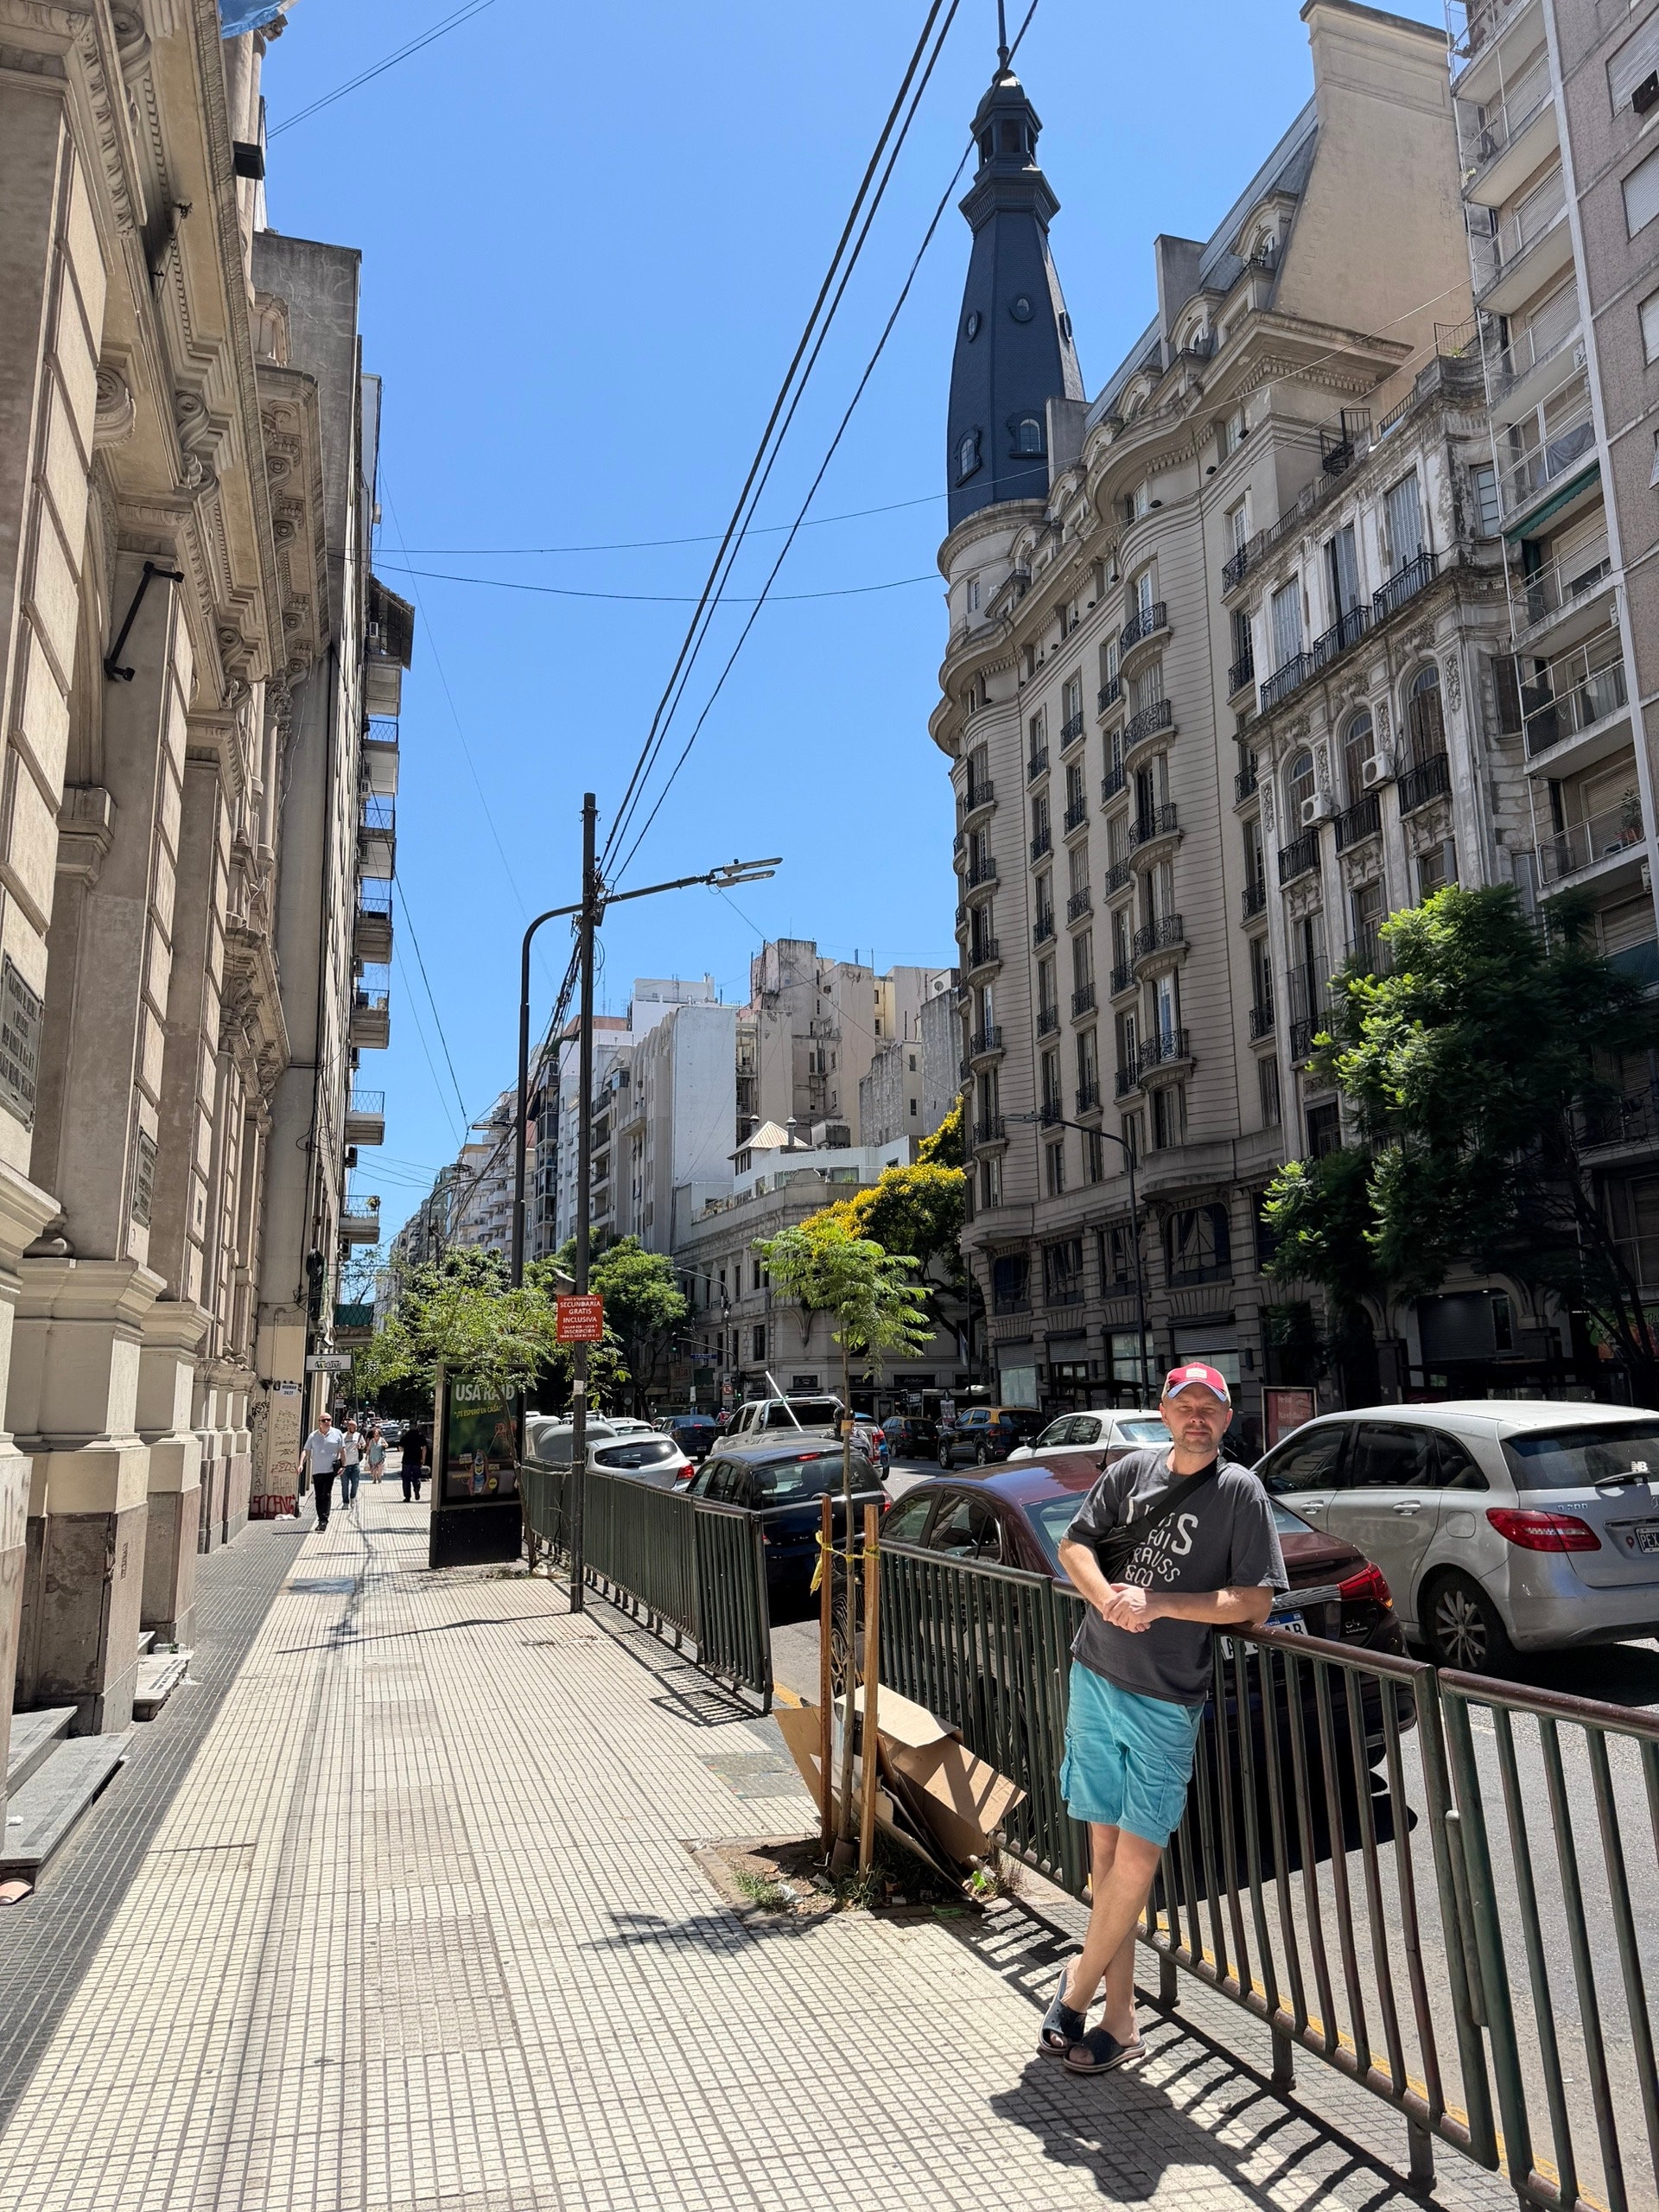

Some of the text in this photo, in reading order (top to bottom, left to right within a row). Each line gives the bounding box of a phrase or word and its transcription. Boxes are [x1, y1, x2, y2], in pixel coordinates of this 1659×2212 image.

[455, 1383, 481, 1402] USA
[1567, 1503, 1588, 1511] 200
[1124, 1547, 1181, 1583] RAUSS
